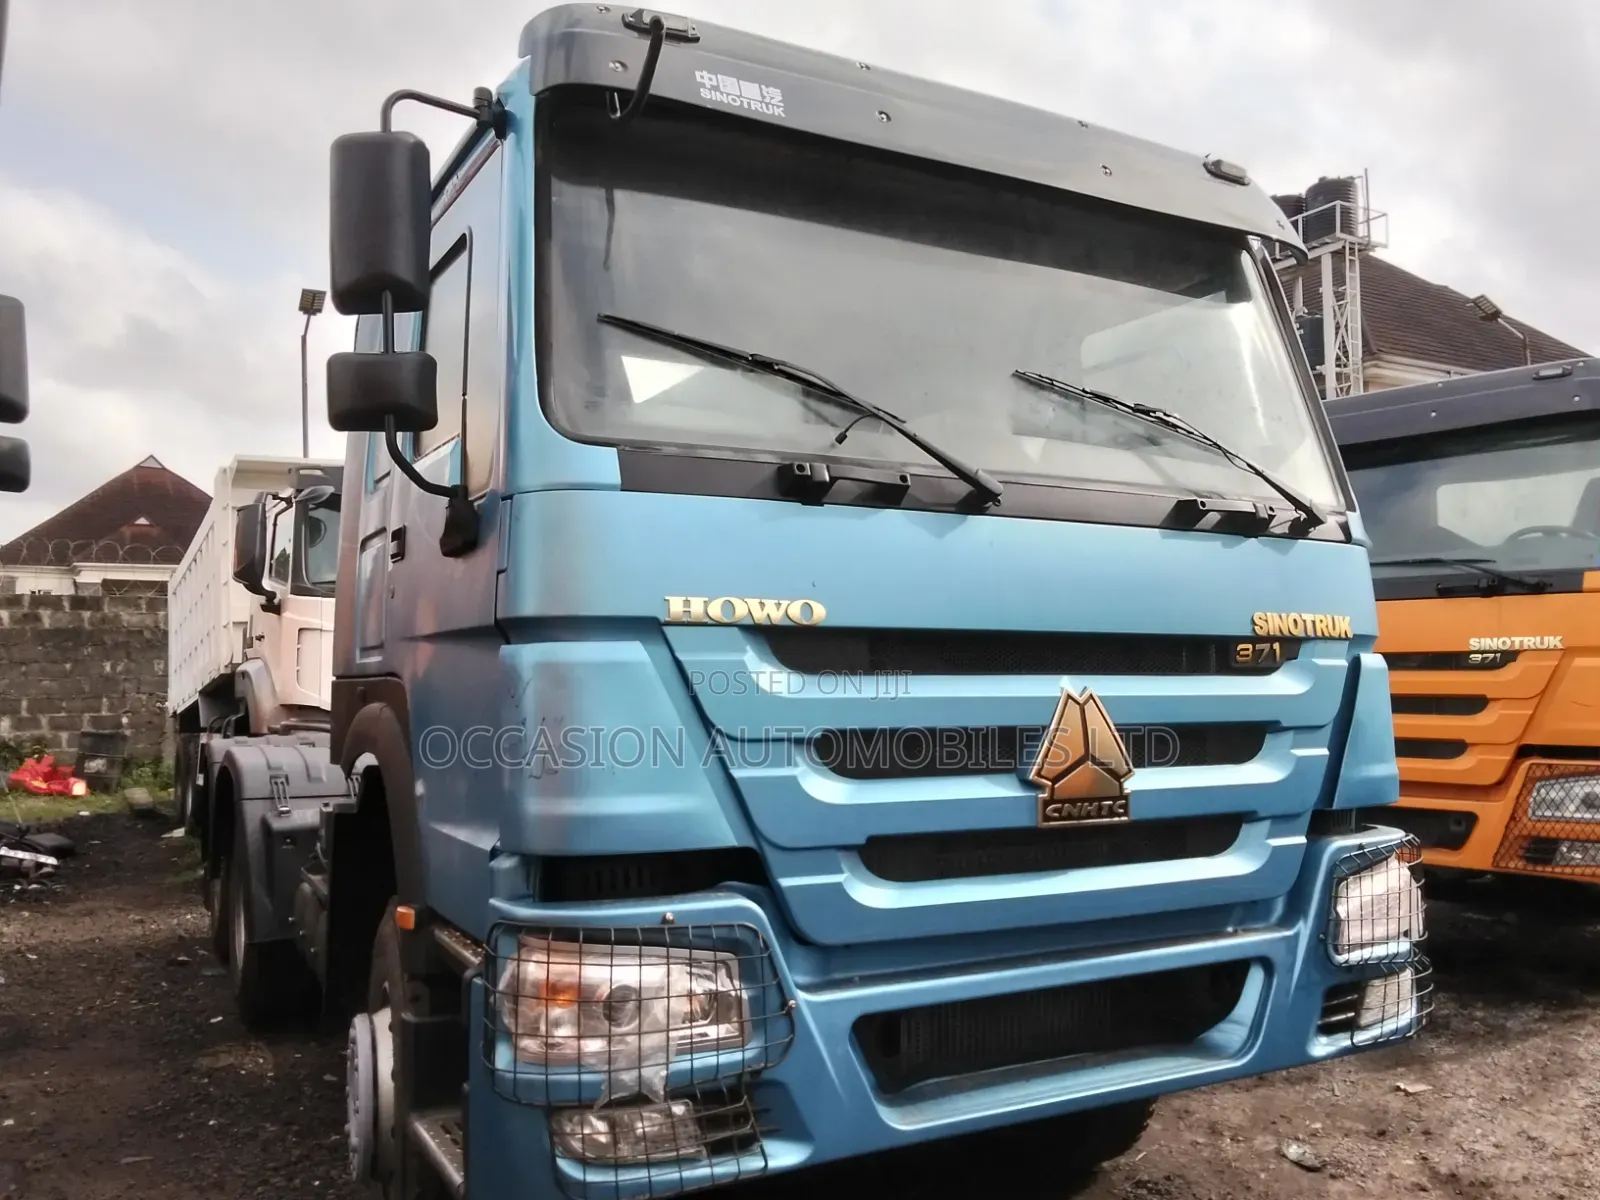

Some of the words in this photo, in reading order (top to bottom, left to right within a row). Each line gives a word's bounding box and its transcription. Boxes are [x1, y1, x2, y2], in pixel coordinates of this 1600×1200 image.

[694, 70, 784, 106] 中国汽
[700, 87, 786, 118] SINOTRUK
[664, 596, 827, 625] HOWO
[1252, 612, 1353, 639] SINOTRUK
[1236, 642, 1280, 664] 371
[1469, 635, 1564, 650] SINOTRUK
[1468, 653, 1502, 663] 371
[1045, 800, 1127, 818] CNHTC
